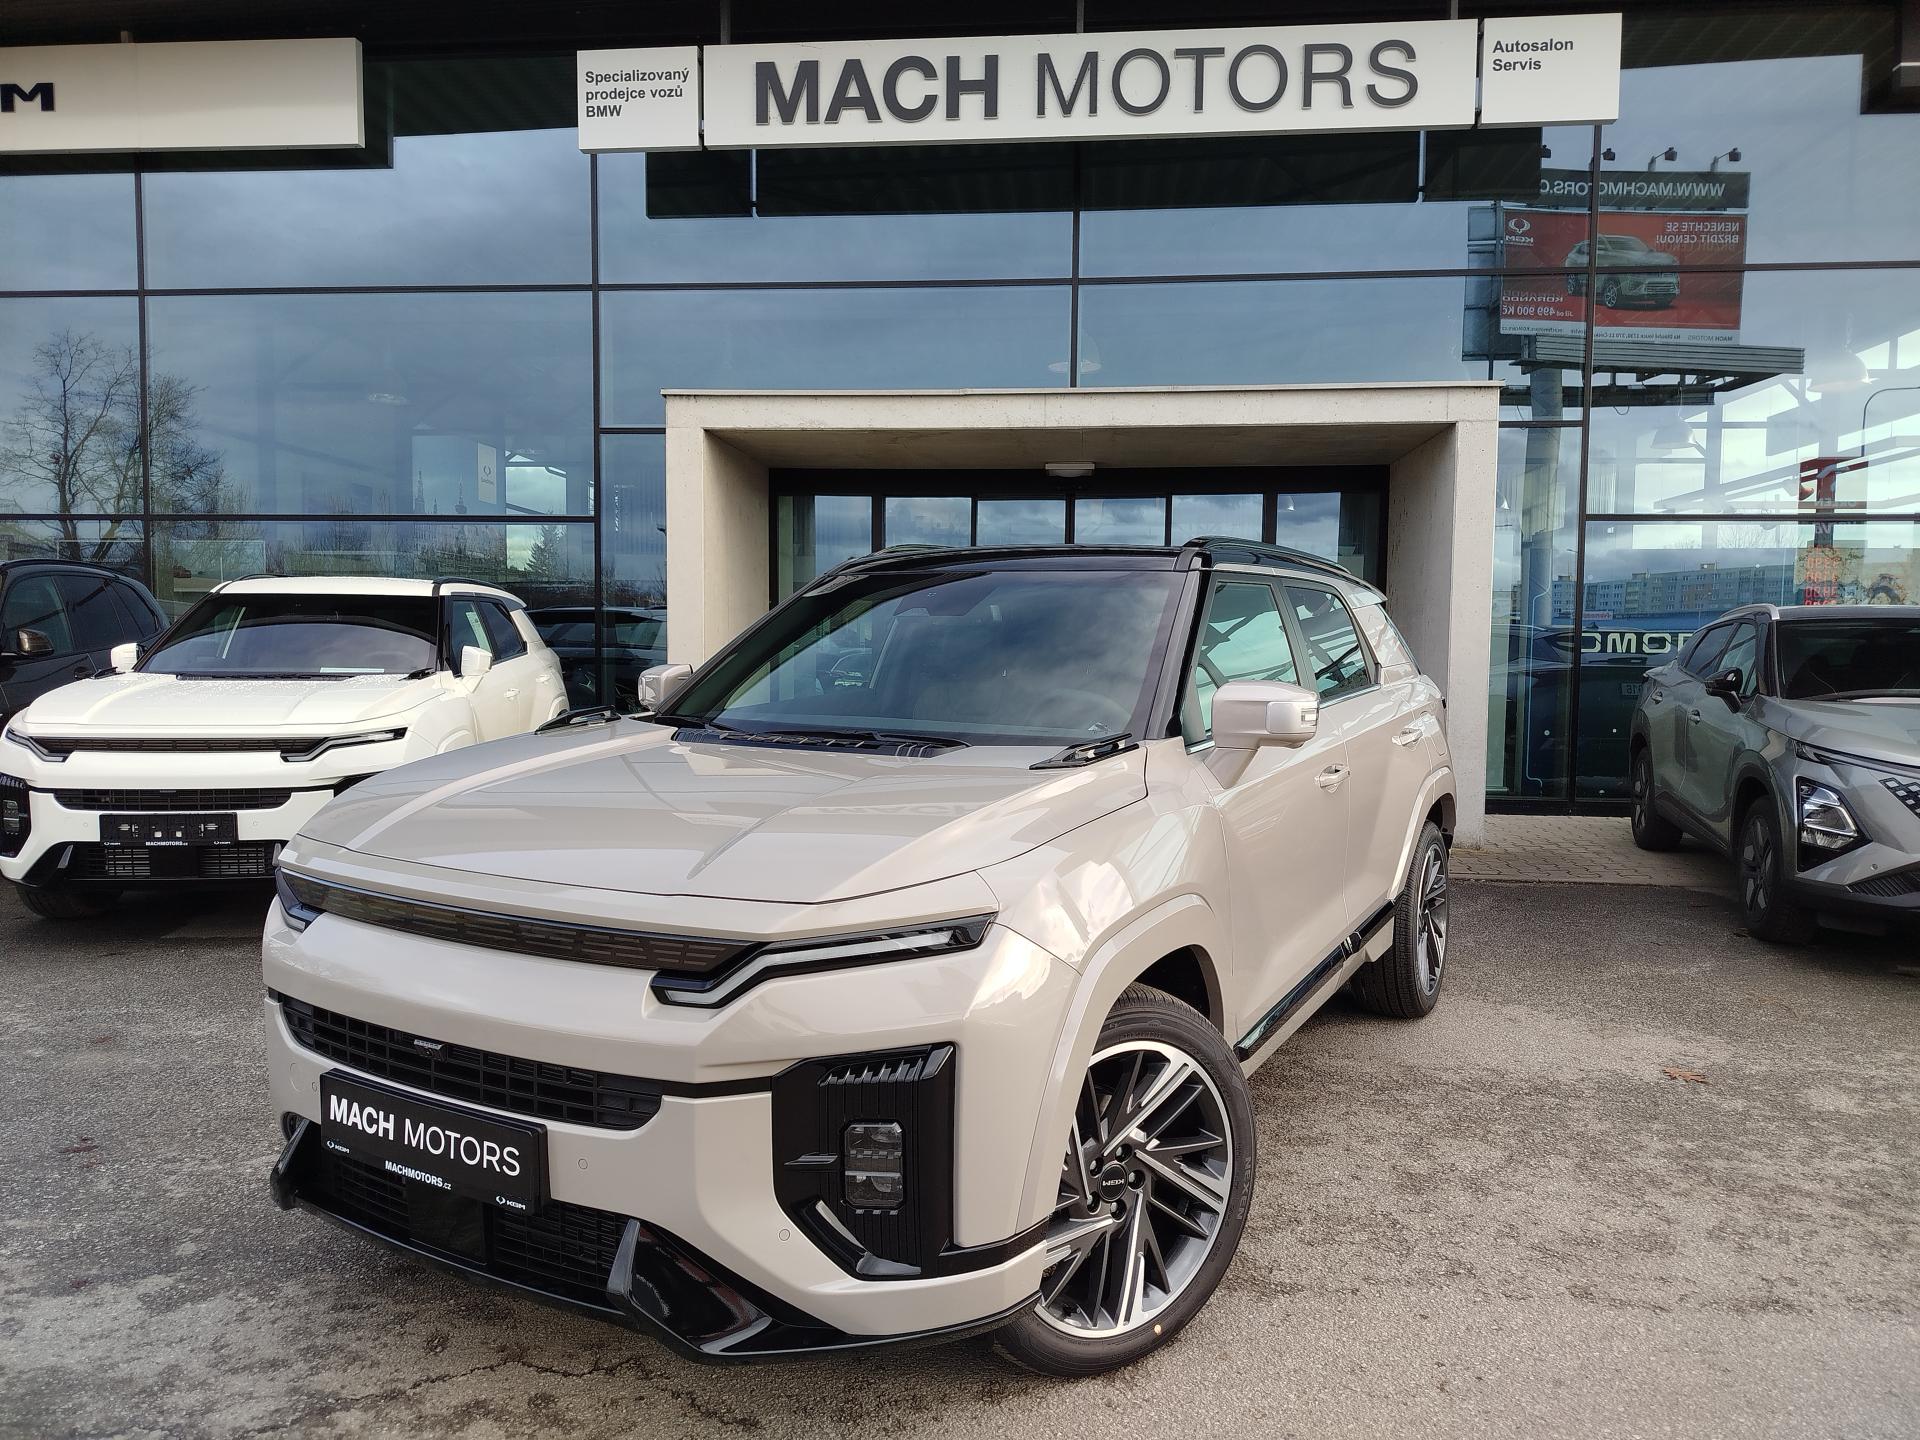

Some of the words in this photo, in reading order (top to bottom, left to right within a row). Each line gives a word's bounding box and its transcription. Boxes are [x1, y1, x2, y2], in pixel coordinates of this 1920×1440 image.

[1492, 37, 1574, 54] Autosalon
[1492, 57, 1542, 72] Servis
[585, 67, 690, 86] Specializovaný
[755, 54, 999, 125] MACH
[1036, 39, 1419, 118] MOTORS
[585, 87, 647, 103] prodejce
[650, 85, 683, 98] vozů
[586, 105, 622, 118] BMW
[329, 1094, 395, 1141] MACH
[404, 1118, 521, 1177] MOTORS
[385, 1160, 452, 1191] MACHMOTORS.cz
[1102, 1177, 1126, 1187] KGM
[1235, 1155, 1252, 1221] NEXEN
